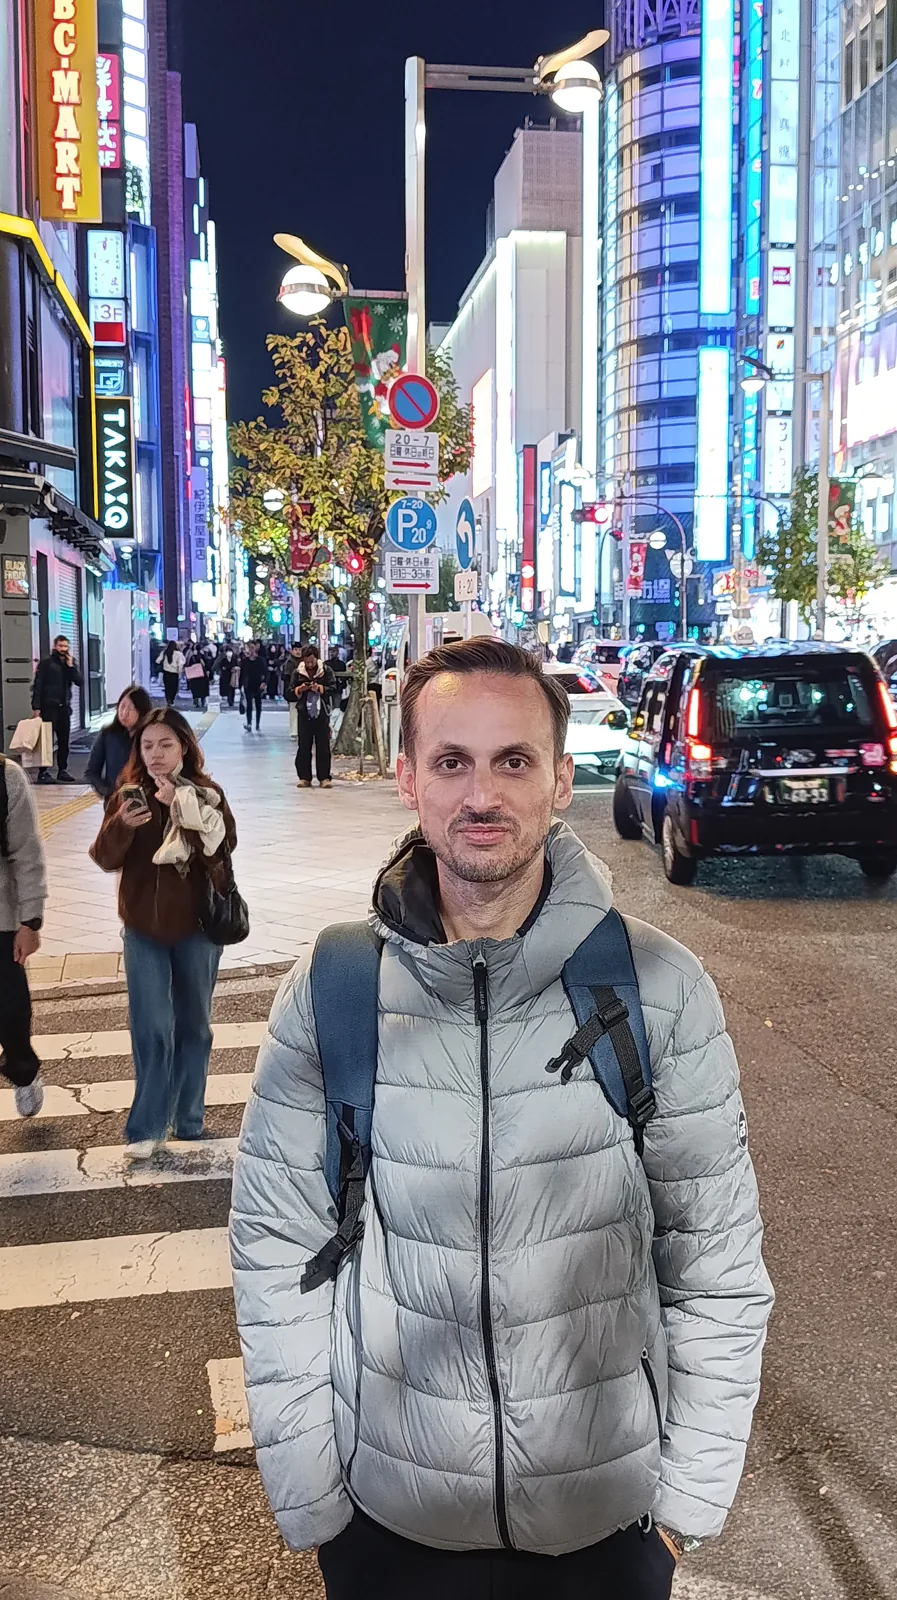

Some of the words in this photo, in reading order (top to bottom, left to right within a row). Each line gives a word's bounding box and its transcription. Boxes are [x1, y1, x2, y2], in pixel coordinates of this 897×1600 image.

[100, 304, 122, 320] 3F
[395, 434, 430, 447] 20-7
[401, 500, 423, 509] 7-20
[398, 509, 418, 542] P
[411, 528, 427, 543] 20
